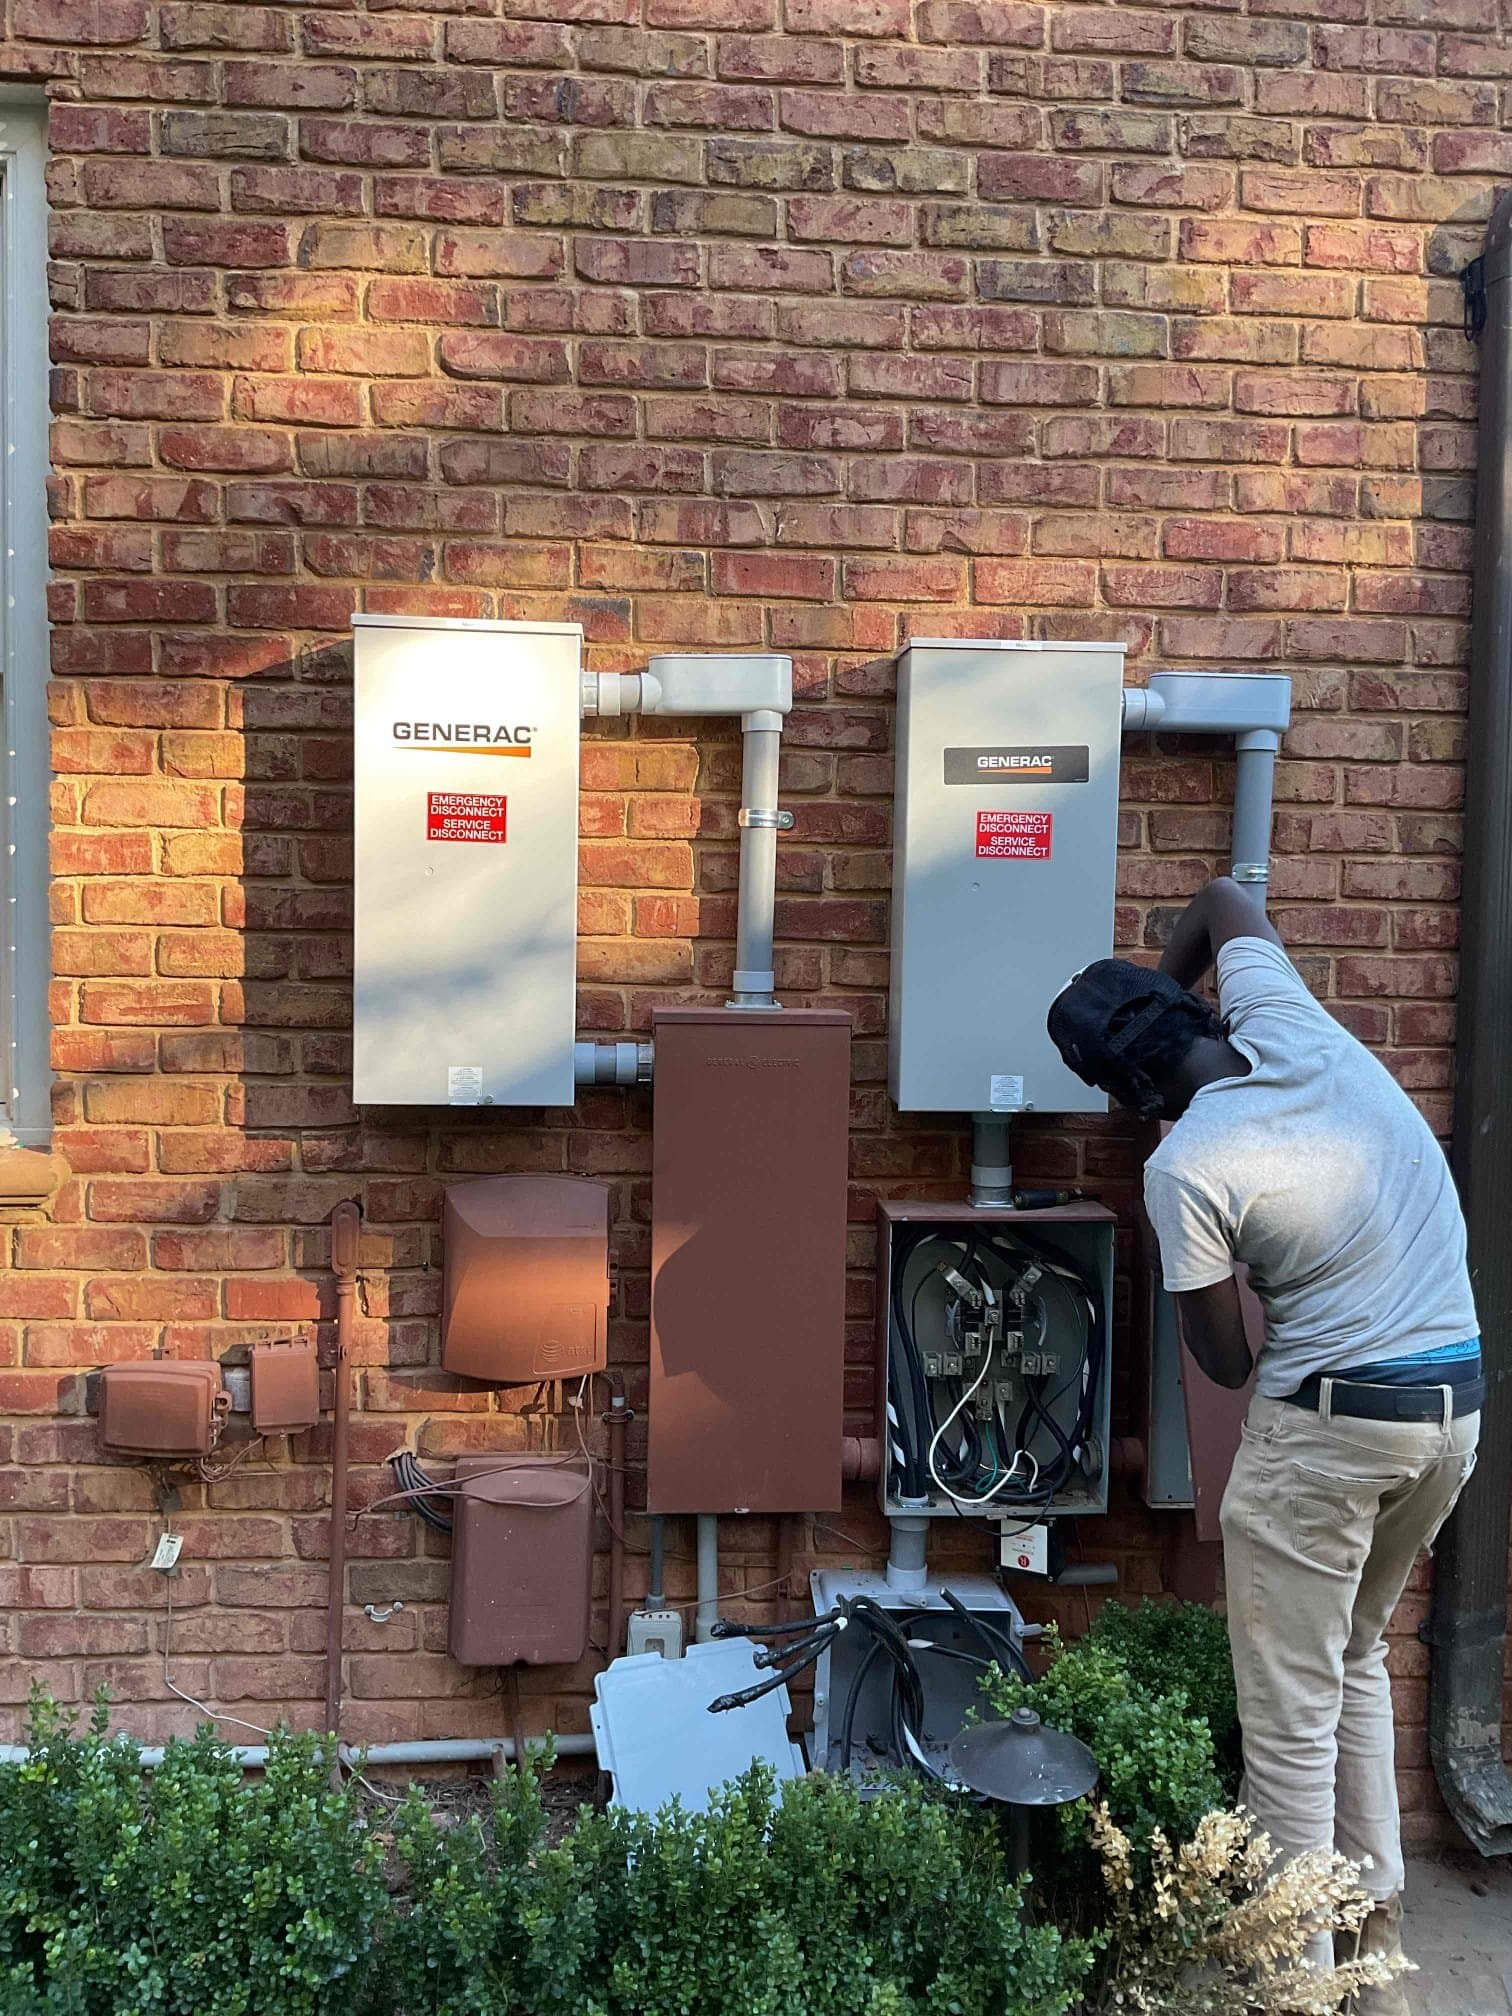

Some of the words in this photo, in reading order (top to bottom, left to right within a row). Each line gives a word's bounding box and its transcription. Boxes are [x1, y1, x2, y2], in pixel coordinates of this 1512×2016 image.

[393, 722, 531, 743] GENERAC
[977, 755, 1052, 767] GENERAC
[431, 795, 503, 807] EMERGENCY
[430, 806, 504, 817] DISCONNECT
[443, 819, 491, 829] SERVICE
[980, 813, 1048, 824] EMERGENCY
[430, 829, 504, 840] DISCONNECT
[979, 824, 1048, 834] DISCONNECT
[990, 837, 1036, 846] SERVICE
[978, 846, 1048, 856] DISCONNECT
